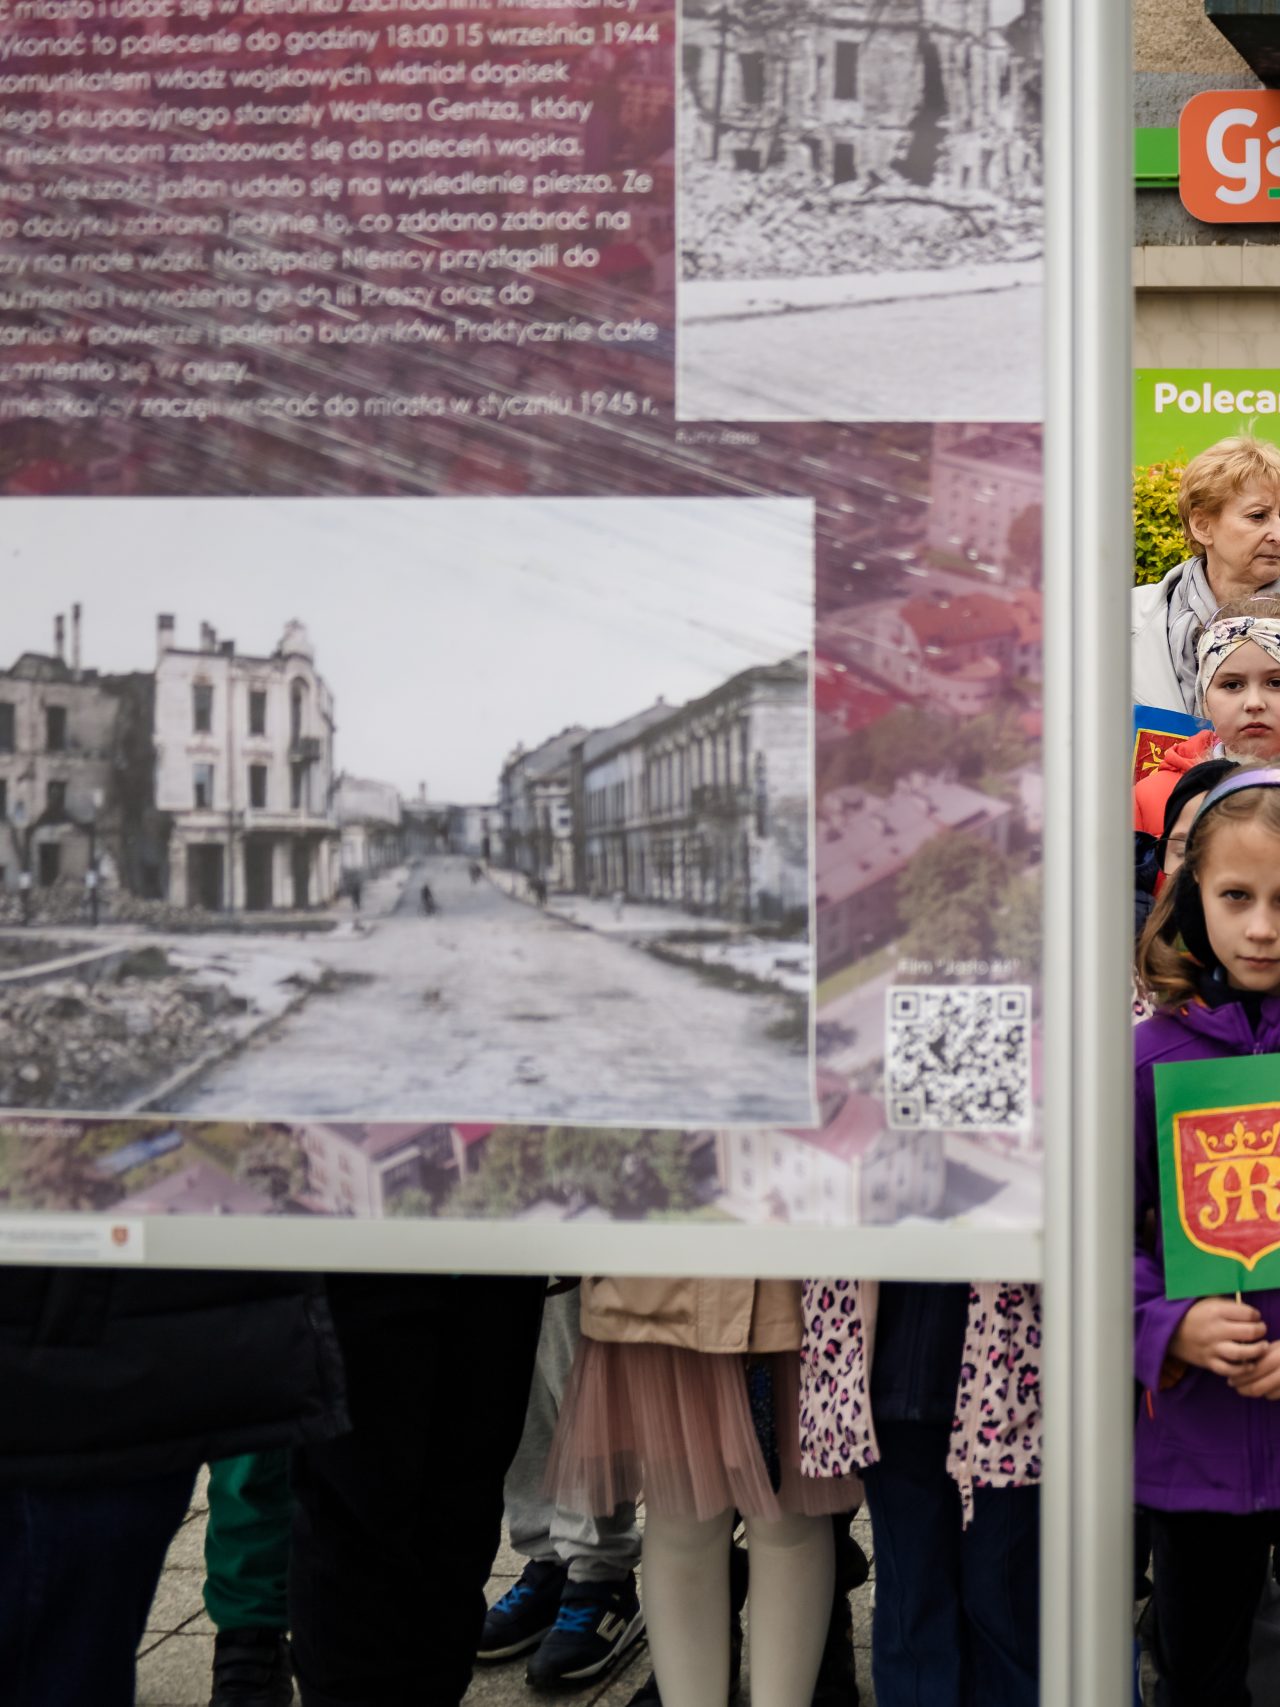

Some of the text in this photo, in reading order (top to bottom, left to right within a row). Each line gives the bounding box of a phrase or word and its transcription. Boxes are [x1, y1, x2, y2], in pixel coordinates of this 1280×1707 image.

[92, 34, 117, 55] to
[121, 29, 242, 58] polecenie
[246, 27, 281, 52] do
[284, 23, 379, 56] godziny
[386, 23, 449, 48] 18:00
[456, 23, 483, 47] 15
[487, 24, 596, 46] września
[603, 21, 660, 45] 1944
[230, 63, 371, 92] wojskowych
[470, 59, 570, 88] dopisek
[57, 103, 230, 132] okupacyjnego
[234, 101, 324, 128] starosty
[330, 100, 422, 123] Waltera
[427, 97, 524, 123] Gentza,
[531, 96, 593, 124] który
[311, 138, 344, 165] się
[348, 133, 384, 159] do
[388, 132, 491, 164] poleceń
[495, 132, 585, 161] wojska.
[348, 177, 382, 196] na
[385, 170, 527, 199] wysiedlenie
[533, 170, 617, 197] pieszo.
[622, 168, 654, 194] Ze
[358, 212, 393, 233] co
[396, 207, 498, 234] zdołano
[501, 205, 591, 232] zabrać
[596, 209, 632, 231] na
[562, 243, 601, 269] do
[296, 282, 332, 307] do
[499, 281, 535, 305] do
[324, 392, 359, 417] do
[450, 396, 471, 415] w
[580, 391, 637, 416] 1945
